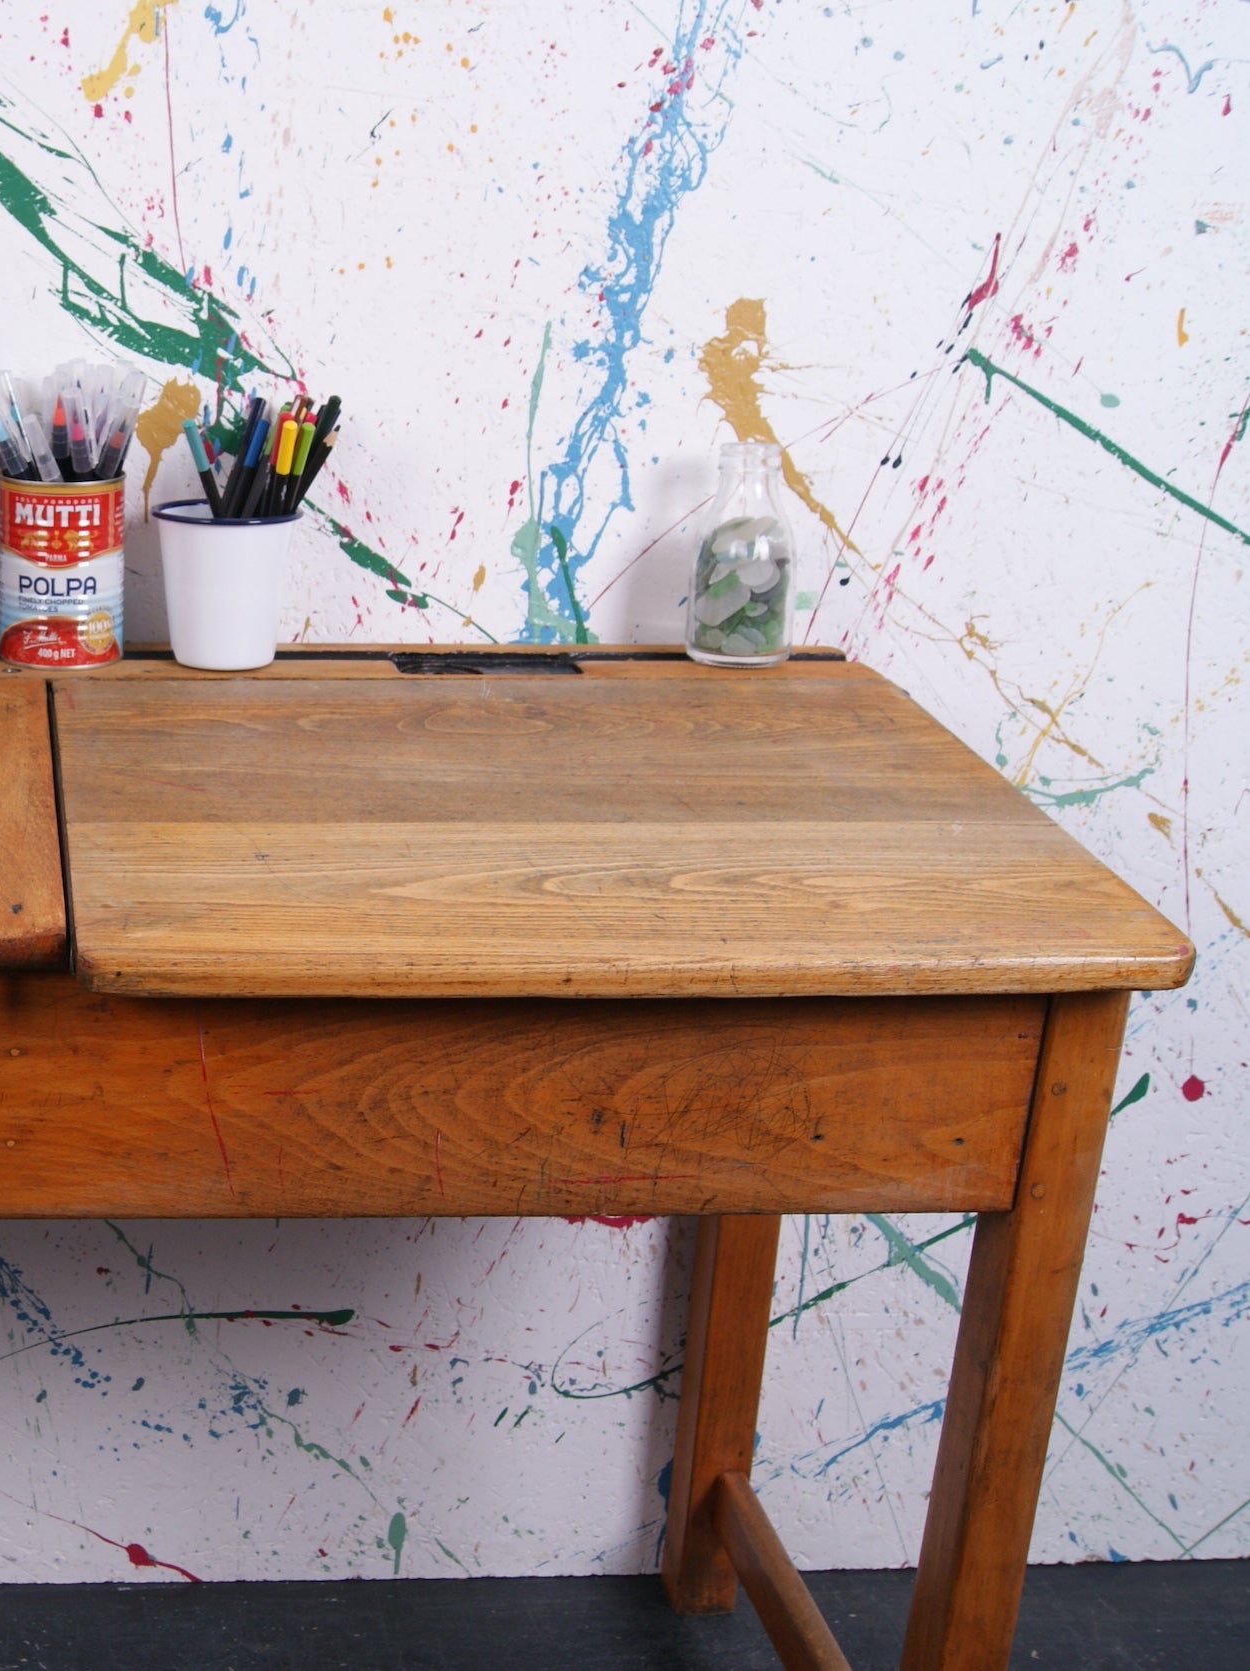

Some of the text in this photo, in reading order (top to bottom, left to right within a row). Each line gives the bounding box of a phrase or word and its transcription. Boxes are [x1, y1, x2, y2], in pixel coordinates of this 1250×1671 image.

[14, 502, 100, 528] MUTTI
[18, 574, 97, 597] POLPA
[18, 596, 84, 606] FINELY CHOPPED
[18, 602, 59, 613] TOMAES
[60, 648, 76, 658] NET
